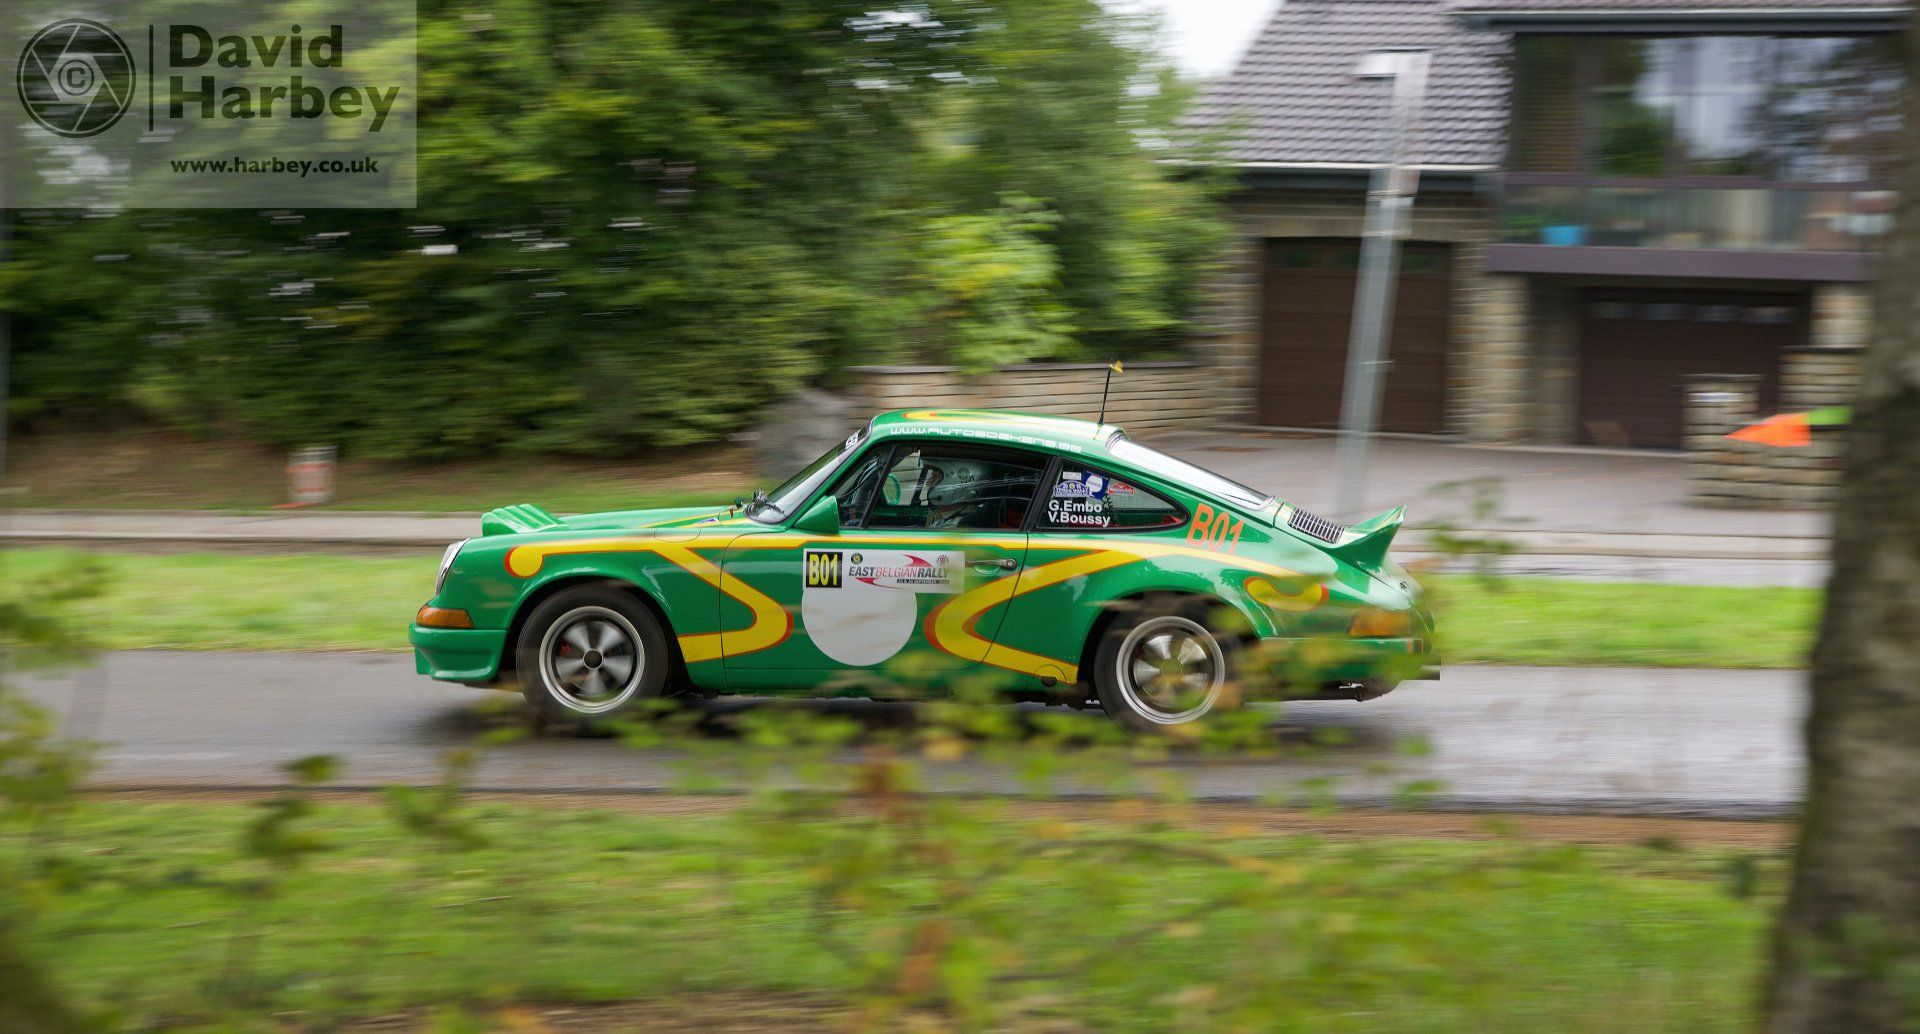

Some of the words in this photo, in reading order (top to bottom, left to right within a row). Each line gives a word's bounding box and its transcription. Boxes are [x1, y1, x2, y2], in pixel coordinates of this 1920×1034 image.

[1048, 500, 1103, 513] G.Embo
[1047, 511, 1111, 527] V.Boussy
[1186, 502, 1245, 554] B01
[808, 553, 838, 586] B01
